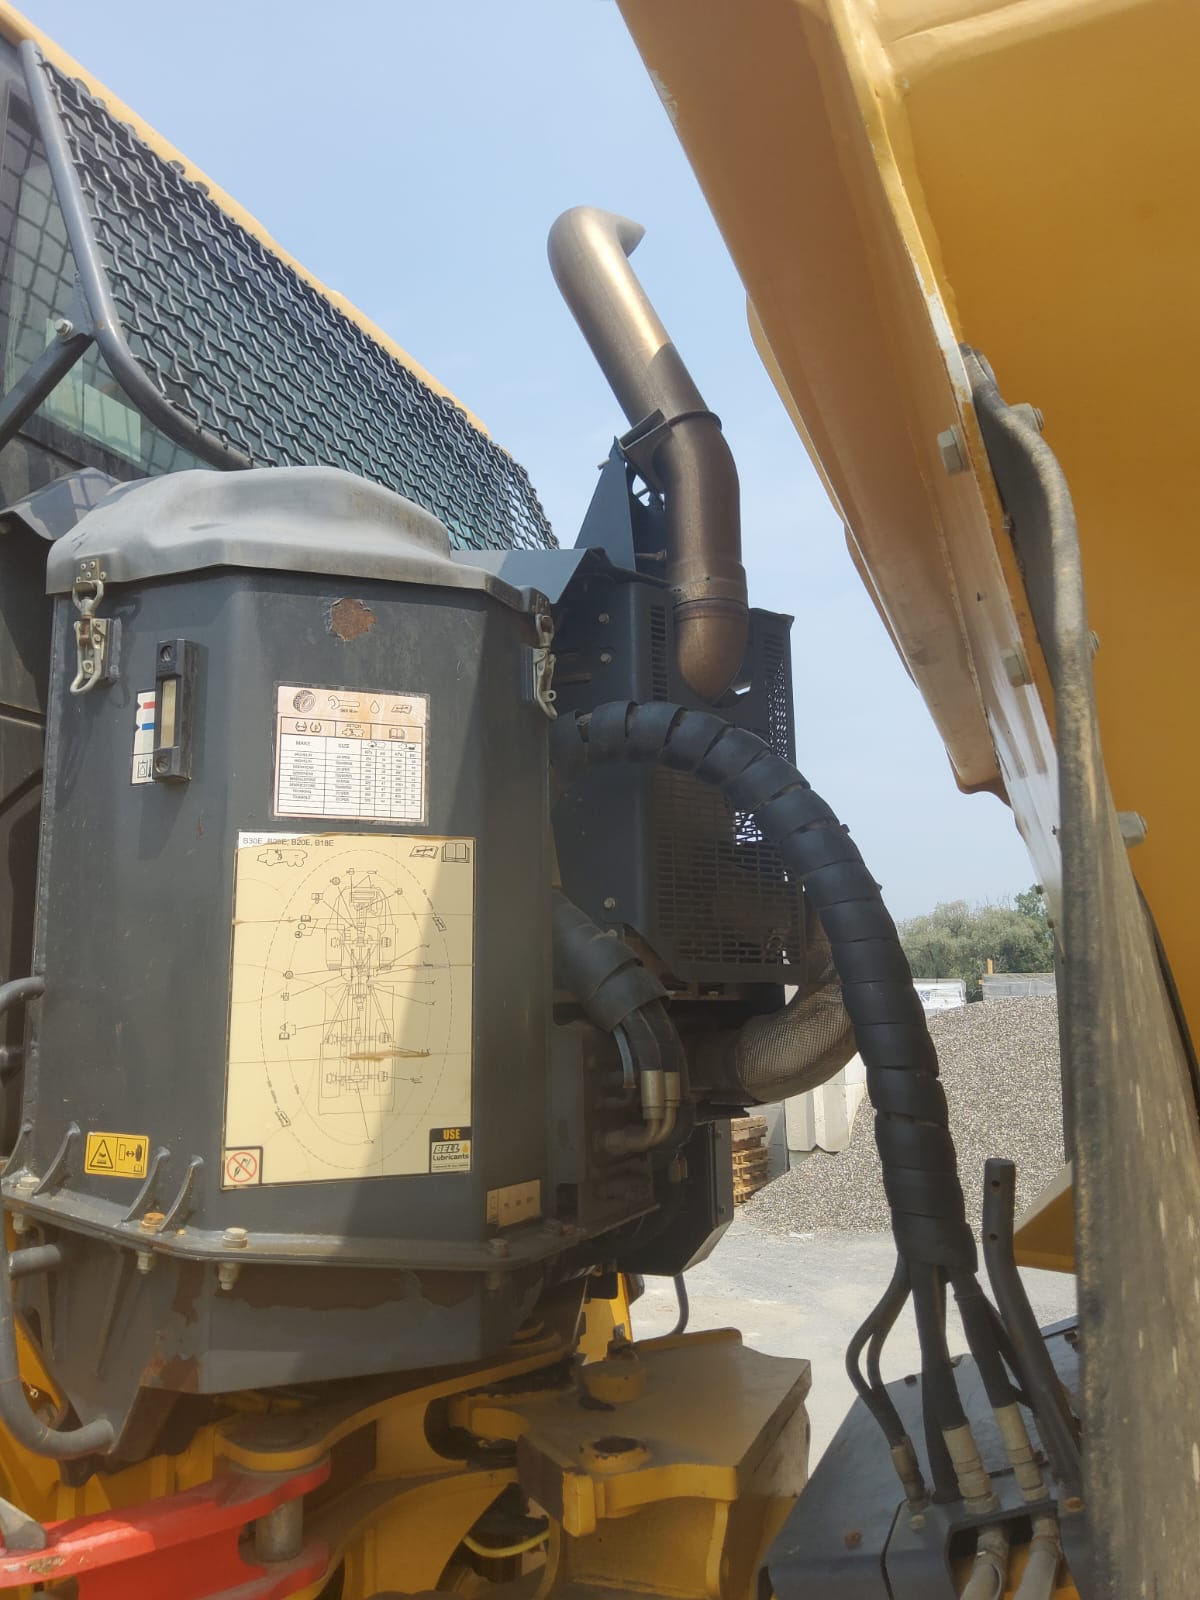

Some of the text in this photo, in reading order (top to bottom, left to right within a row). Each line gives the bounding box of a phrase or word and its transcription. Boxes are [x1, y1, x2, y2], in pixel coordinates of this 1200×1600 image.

[291, 839, 313, 847] B20E,
[314, 839, 335, 847] B18E
[443, 1128, 461, 1140] USE
[434, 1143, 460, 1154] BELL
[432, 1153, 470, 1161] Lubricants
